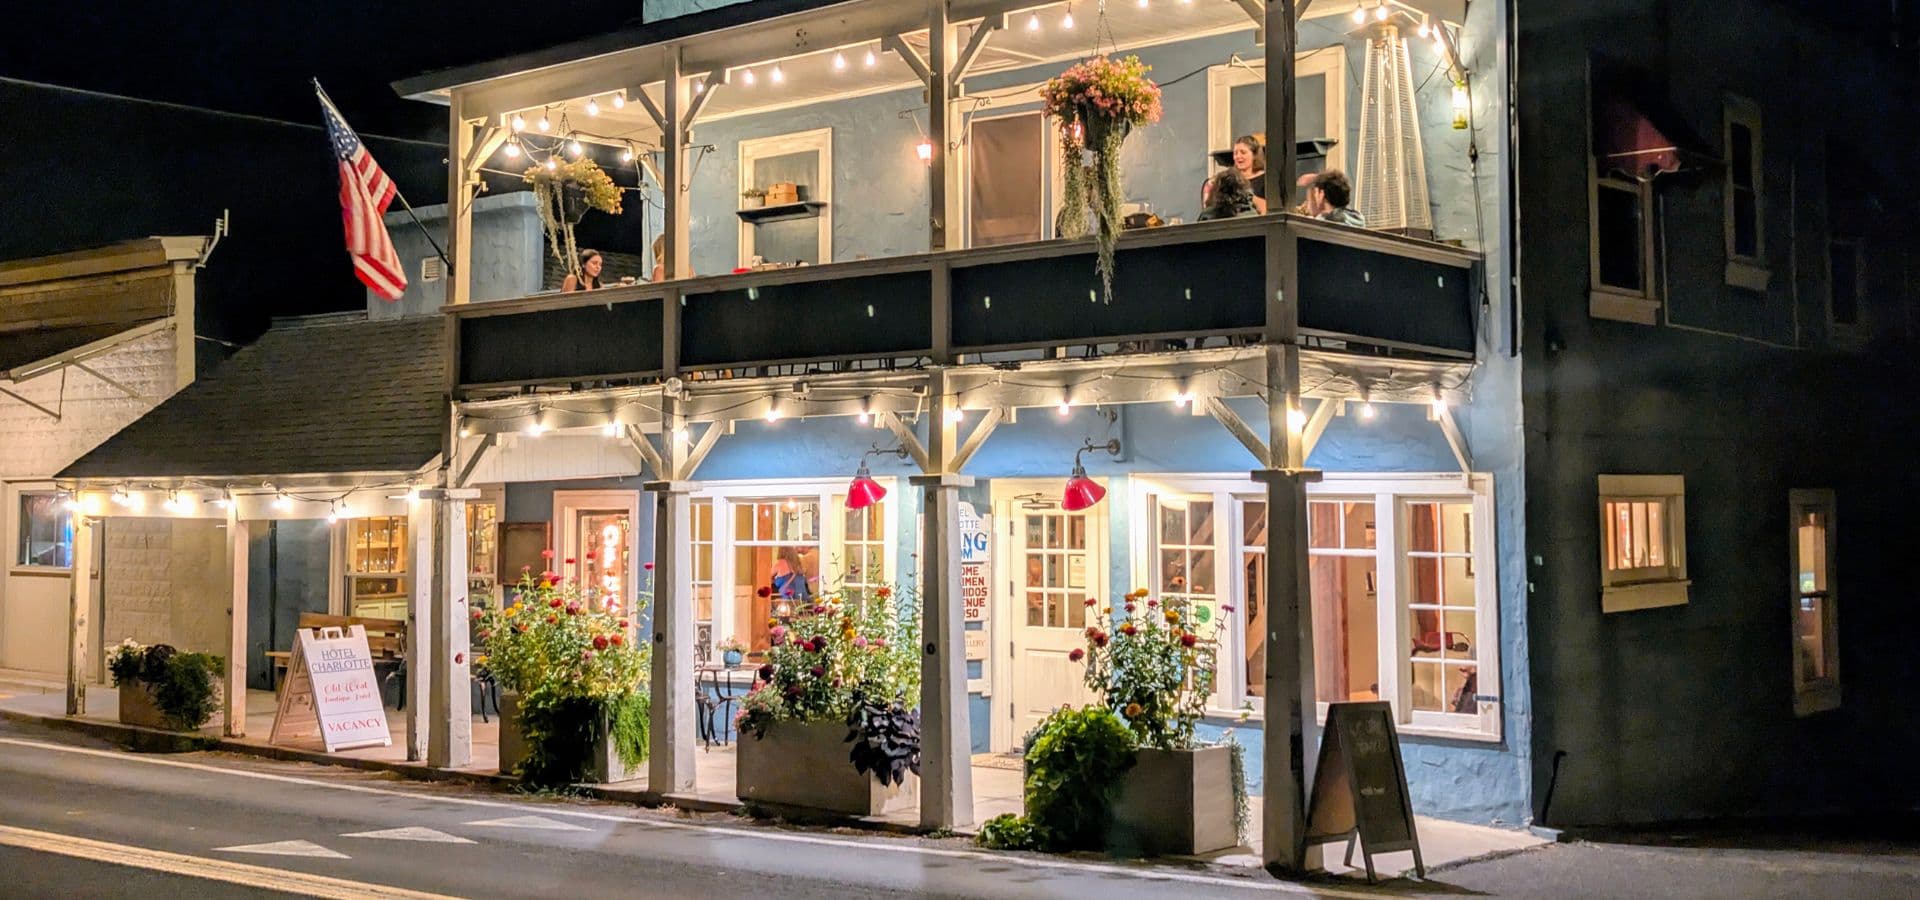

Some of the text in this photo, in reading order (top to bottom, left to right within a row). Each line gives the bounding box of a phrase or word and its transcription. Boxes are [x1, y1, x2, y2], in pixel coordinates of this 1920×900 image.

[321, 648, 355, 660] HOTEL
[311, 659, 371, 672] CHARLOTTE
[328, 719, 382, 732] VACANCY
